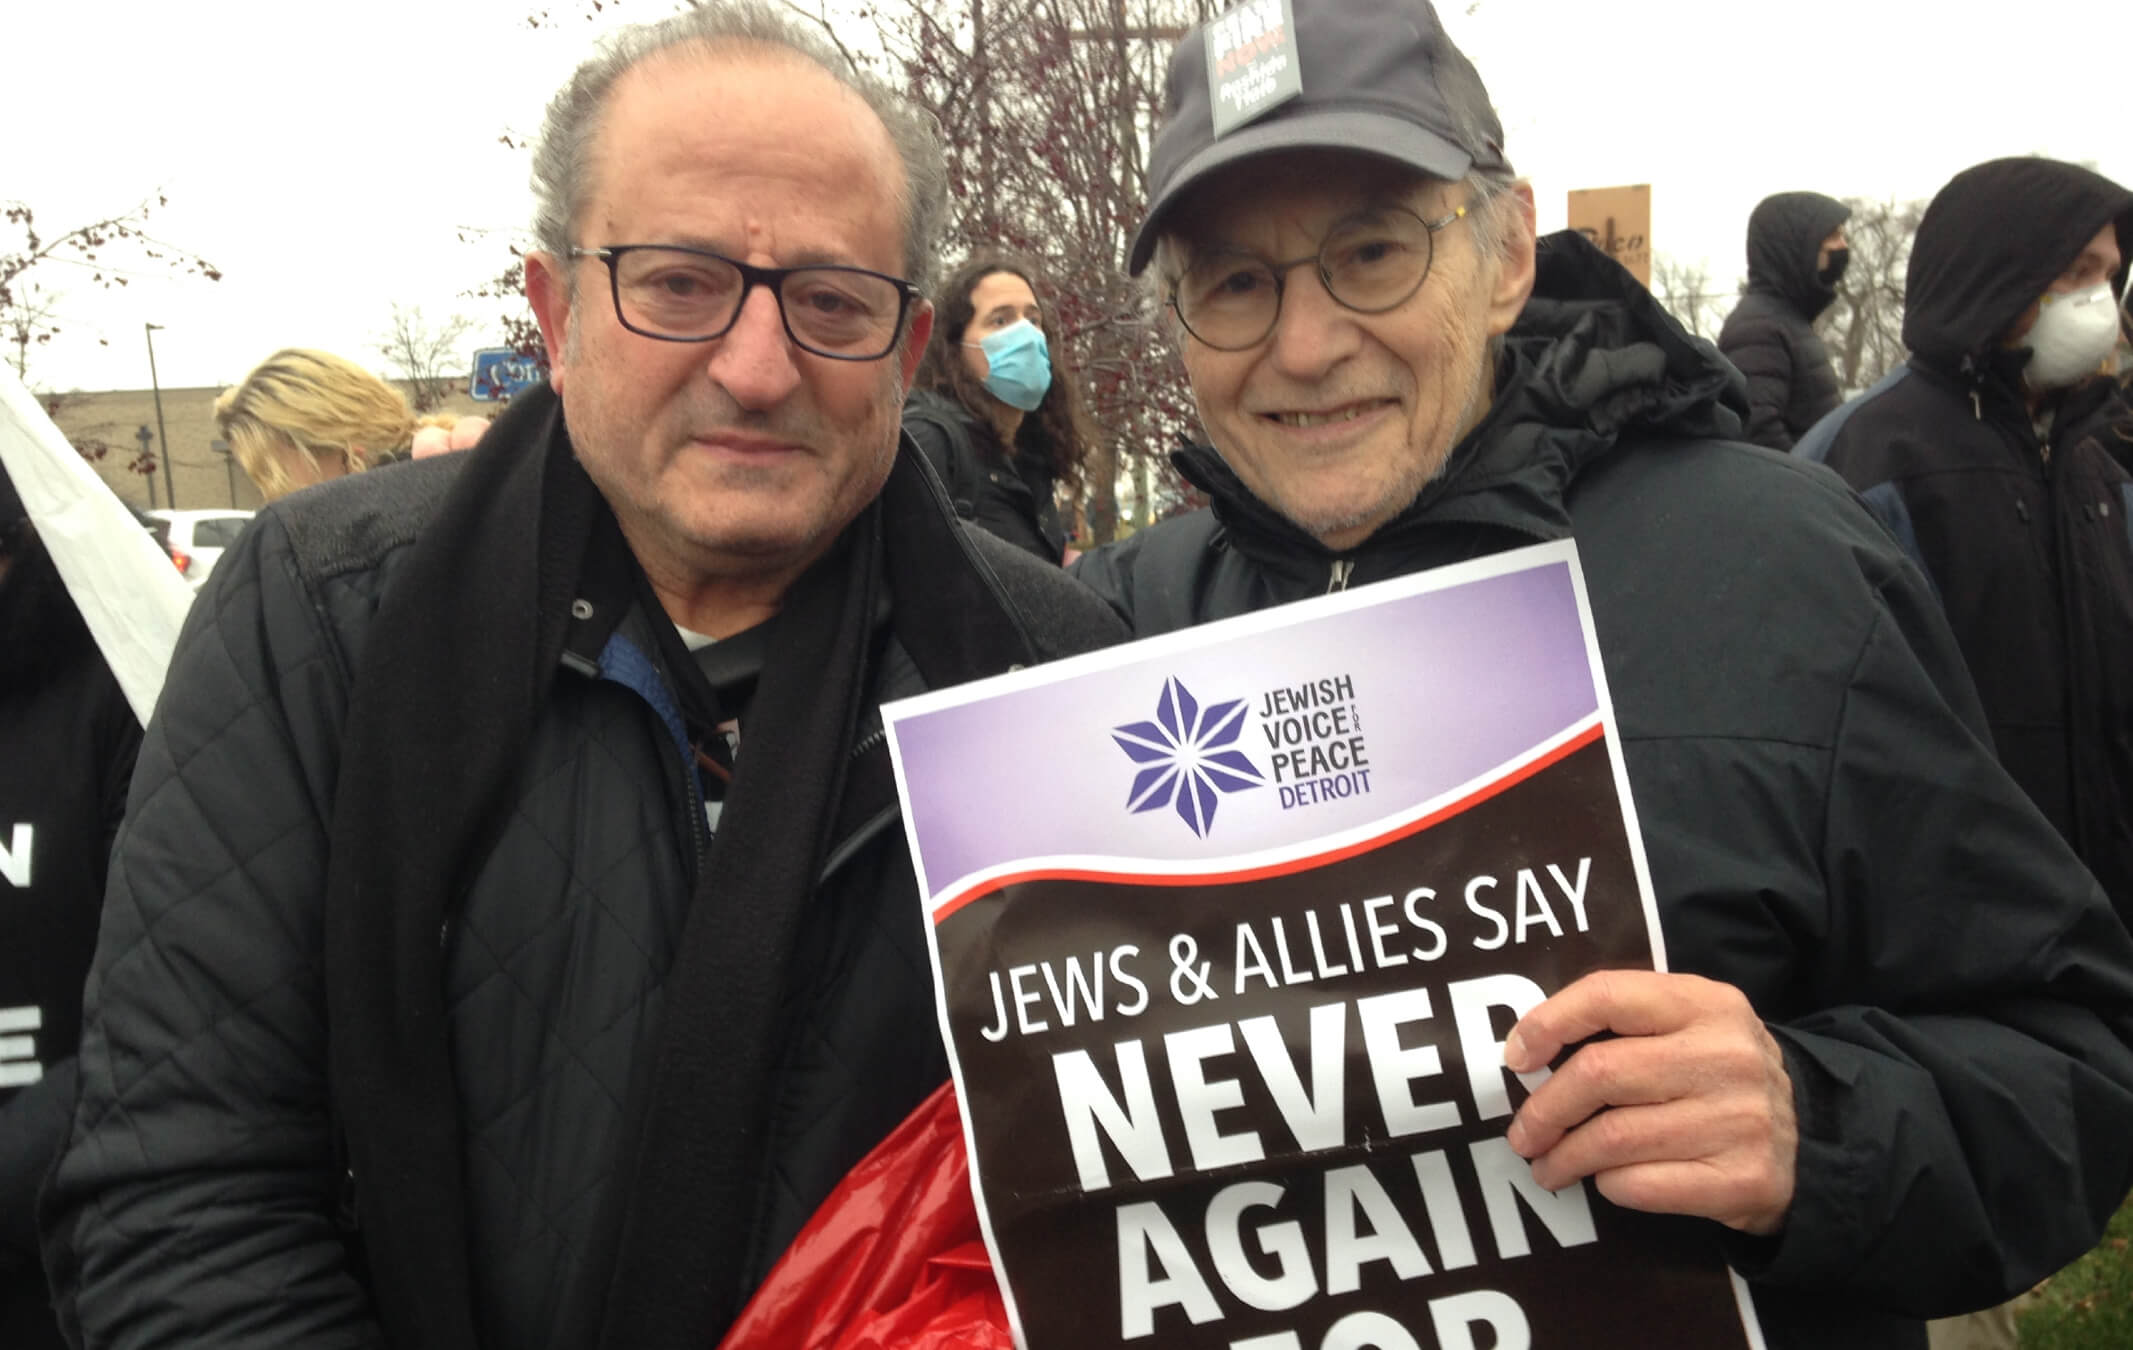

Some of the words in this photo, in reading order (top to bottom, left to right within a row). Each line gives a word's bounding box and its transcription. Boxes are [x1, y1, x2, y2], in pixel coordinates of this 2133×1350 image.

[1259, 674, 1354, 718] JEWISH
[1350, 704, 1361, 732] FOR
[1263, 706, 1350, 749] VOICE
[1271, 736, 1369, 783] PEACE
[1278, 769, 1372, 810] DETROIT
[979, 944, 1148, 1042] JEWS
[1168, 933, 1219, 1005] &
[1234, 887, 1447, 994] ALLIES
[1464, 857, 1592, 950] SAY
[1052, 973, 1553, 1192] NEVER
[1115, 1136, 1599, 1340] AGAIN
